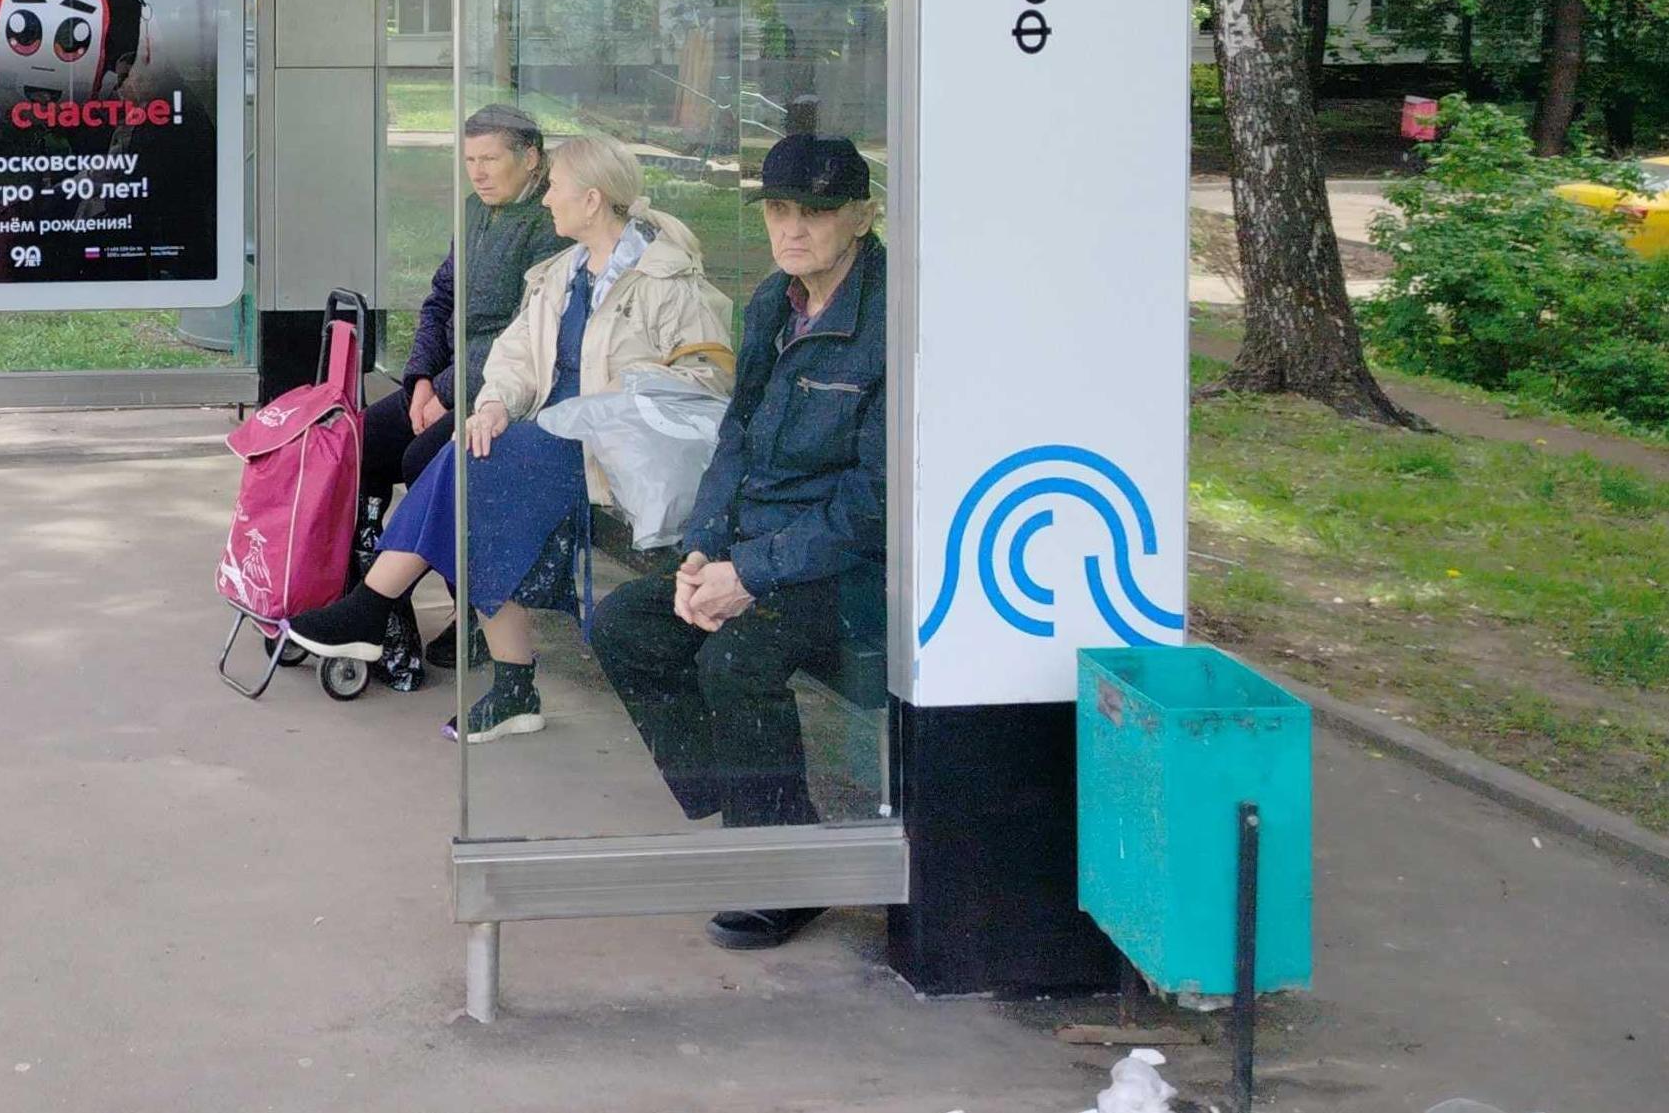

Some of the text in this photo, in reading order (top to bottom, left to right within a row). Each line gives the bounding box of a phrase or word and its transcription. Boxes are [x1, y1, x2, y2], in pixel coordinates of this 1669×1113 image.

[10, 90, 183, 129] счастье!
[61, 177, 95, 201] 90
[99, 176, 149, 200] лет!
[39, 213, 133, 235] рождения!
